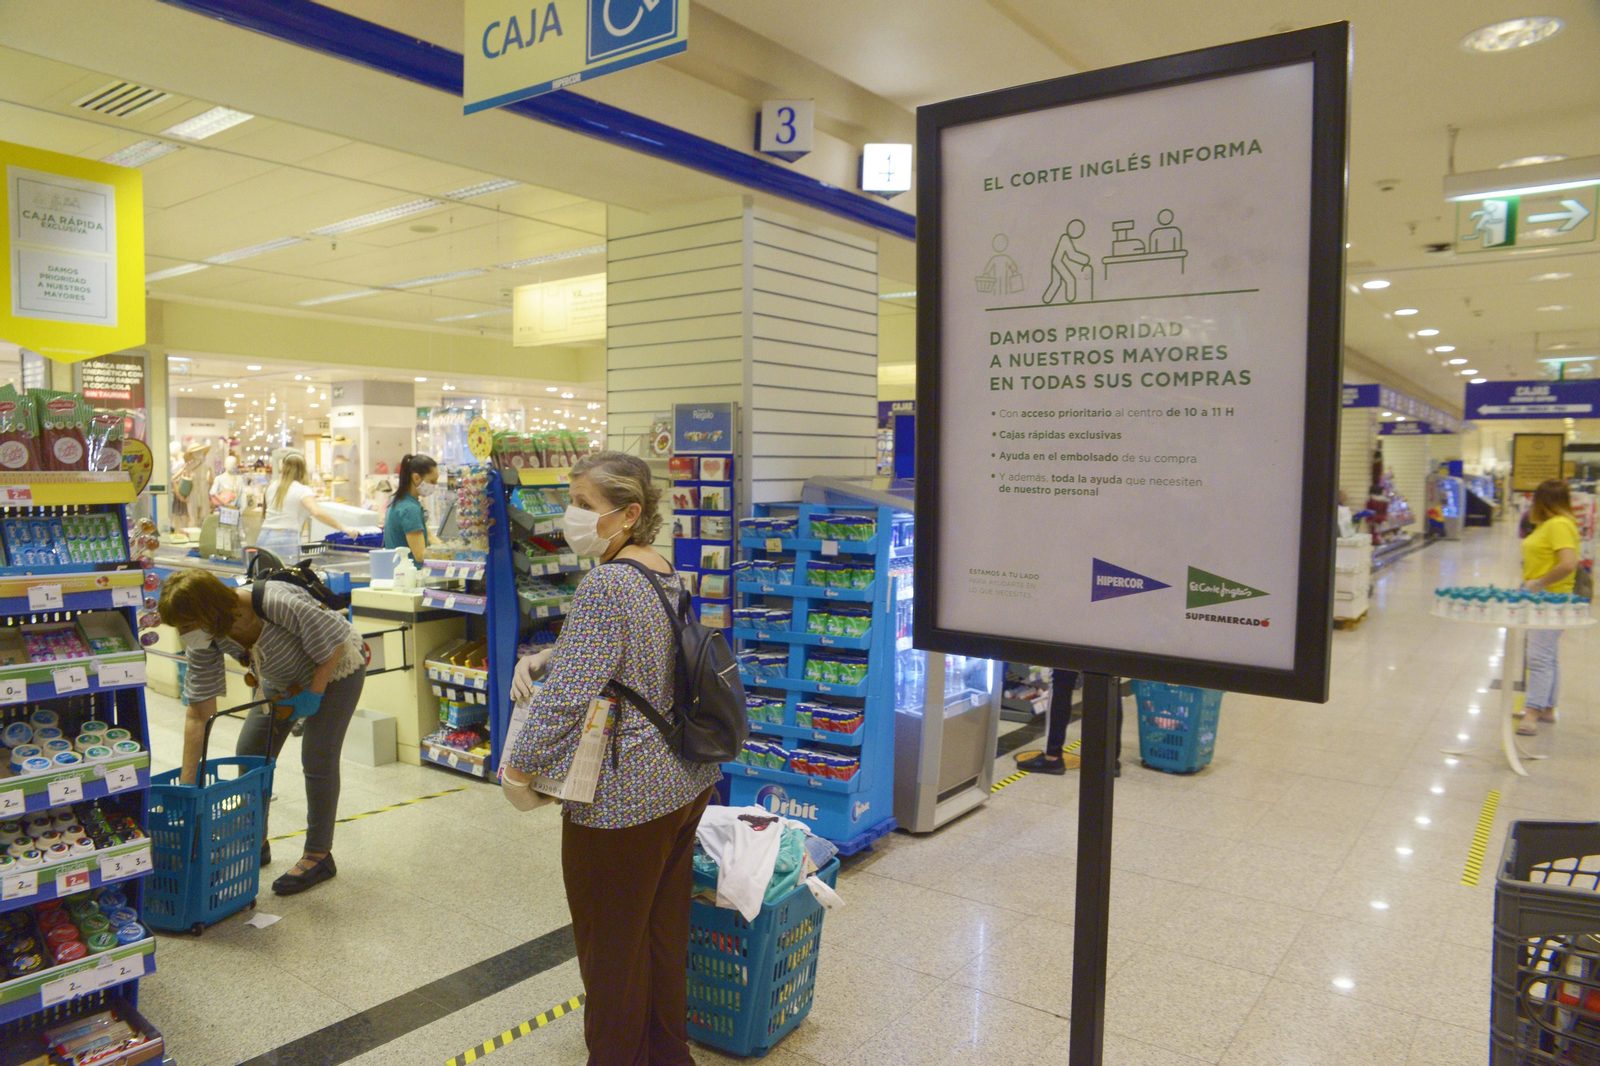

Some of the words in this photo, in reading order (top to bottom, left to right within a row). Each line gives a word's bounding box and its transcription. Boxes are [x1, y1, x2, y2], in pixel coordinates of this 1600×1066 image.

[481, 2, 563, 59] CAJA
[552, 73, 581, 89] HIPERCOR
[775, 106, 797, 144] 3
[983, 177, 1003, 191] EL
[1011, 166, 1072, 188] CORTE
[1080, 153, 1151, 178] INGLÉS
[1160, 139, 1263, 167] INFORMA
[22, 210, 56, 222] CAJA
[60, 215, 103, 231] RÁPIDA
[41, 221, 87, 234] EXCLUSIVA
[47, 265, 79, 275] DAMOS
[39, 273, 87, 285] PRIORIDAD
[46, 283, 91, 293] NUESTROS
[44, 291, 86, 301] MAYORES
[990, 329, 1057, 345] DAMOS
[1066, 322, 1183, 342] PRIORIDAD
[990, 355, 1001, 368] A
[1010, 350, 1114, 366] NUESTROS
[1122, 345, 1228, 363] MAYORES
[82, 368, 127, 377] ENERGÉTICA
[115, 363, 142, 371] BEBIDA
[89, 383, 131, 391] COCA-COLA
[990, 376, 1016, 390] EN
[1021, 374, 1086, 390] TODAS
[1094, 372, 1133, 389] SUS
[1141, 370, 1251, 387] COMPRAS
[999, 409, 1018, 418] Con
[1021, 410, 1055, 418] acceso
[1058, 408, 1112, 420] prioritario
[1115, 408, 1124, 417] al
[1127, 409, 1162, 417] centro
[1166, 408, 1180, 417] de
[1184, 408, 1197, 417] 10
[1212, 408, 1221, 416] 11
[1225, 408, 1234, 416] H
[999, 430, 1025, 441] Cajas
[1028, 429, 1065, 442] rápidas
[1069, 430, 1121, 440] exclusivas
[999, 451, 1029, 463] Ayuda
[1033, 453, 1045, 461] en
[1049, 452, 1057, 461] el
[1060, 452, 1118, 462] embolsado
[1122, 453, 1135, 463] de
[1139, 455, 1150, 463] su
[1154, 455, 1197, 466] compra
[1000, 473, 1005, 482] Y
[1008, 473, 1049, 484] además,
[1051, 474, 1075, 483] toda
[1078, 475, 1087, 483] la
[1090, 475, 1122, 487] ayuda
[1126, 477, 1145, 488] que
[1149, 477, 1202, 487] necesiten
[999, 484, 1011, 494] de
[1014, 486, 1051, 495] nuestro
[1054, 486, 1098, 497] personal
[1096, 575, 1144, 589] HIPERCOR
[1189, 581, 1199, 592] El
[1199, 583, 1220, 593] Corte
[1220, 582, 1252, 598] Inglés
[756, 784, 820, 820] Orbit
